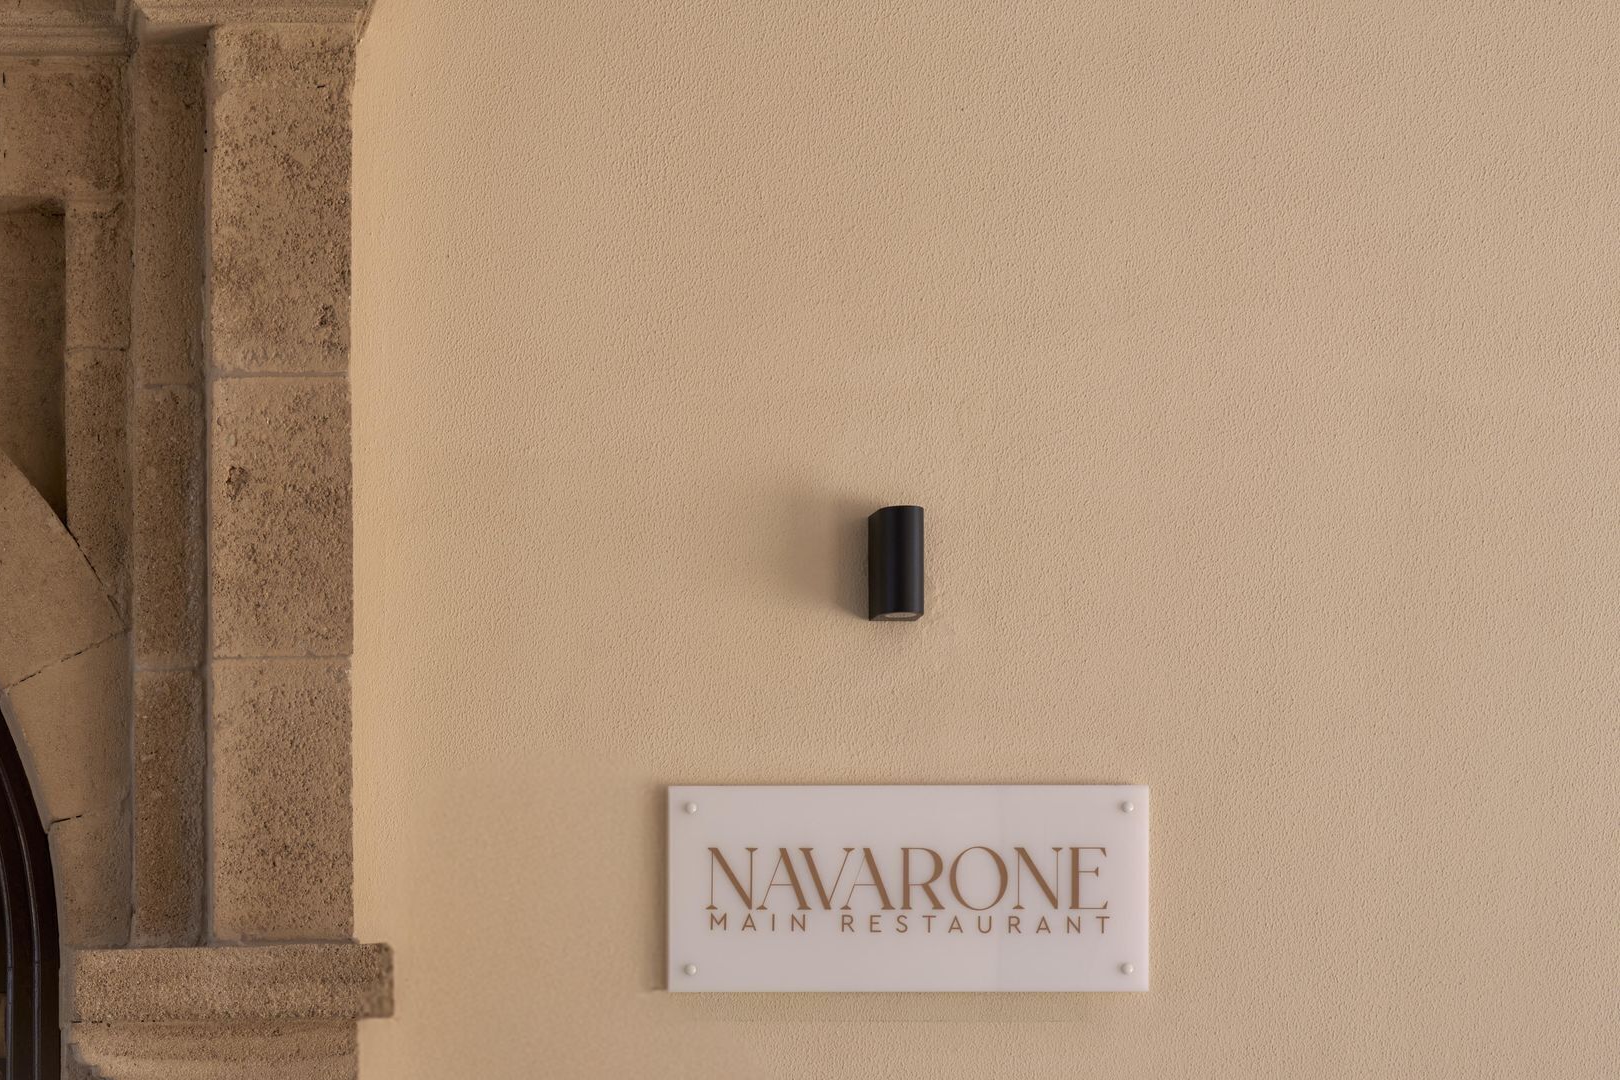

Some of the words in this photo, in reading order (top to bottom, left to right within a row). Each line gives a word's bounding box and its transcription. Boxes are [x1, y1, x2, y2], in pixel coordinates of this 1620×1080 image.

[706, 846, 1108, 911] NAVARONE
[710, 912, 807, 932] MAIN
[841, 914, 1110, 934] RESTAURANT
